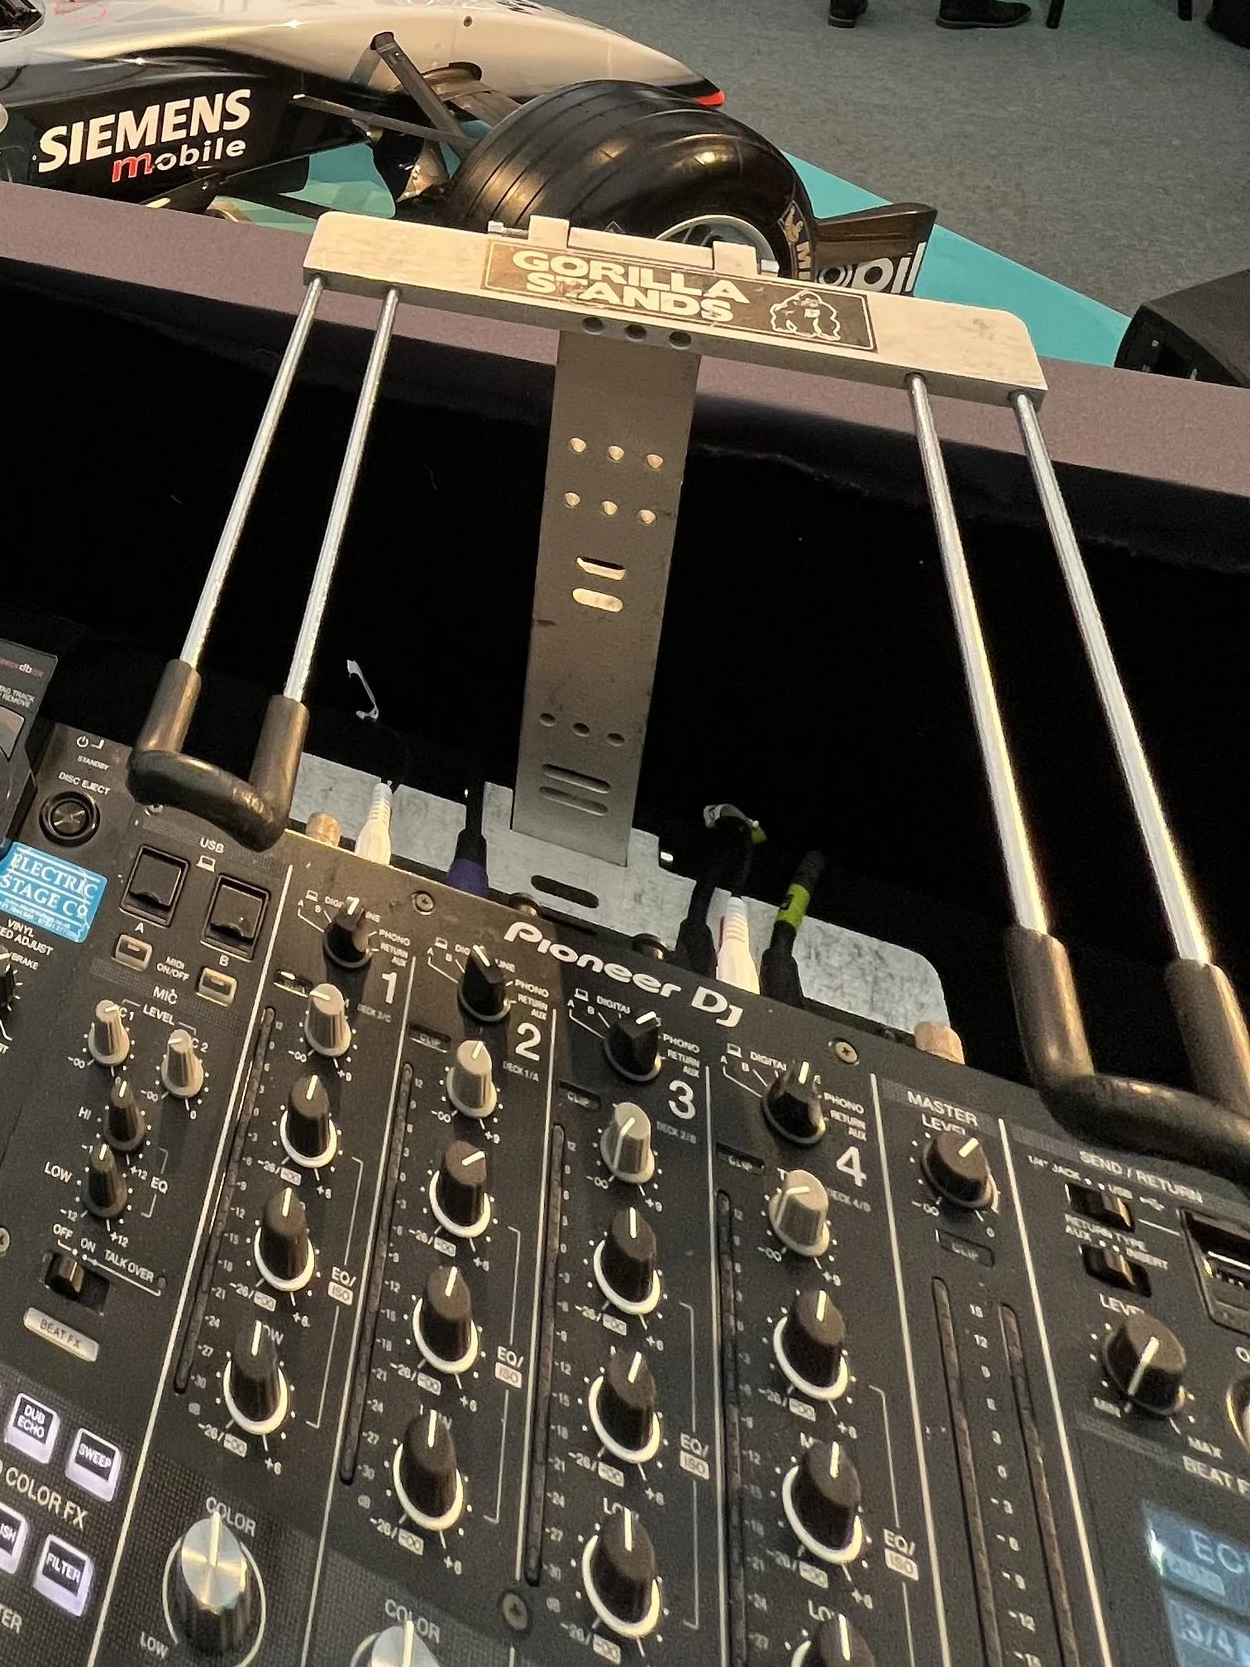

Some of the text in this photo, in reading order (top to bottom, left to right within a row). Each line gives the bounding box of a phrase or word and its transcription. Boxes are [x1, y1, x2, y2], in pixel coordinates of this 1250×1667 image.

[38, 89, 251, 173] SIEMENS
[112, 137, 246, 182] mobile
[512, 250, 750, 303] GORILLA
[527, 270, 734, 323] STANDS
[58, 772, 110, 796] DISC EJECT
[200, 838, 224, 854] USB
[11, 853, 98, 899] ELECTRIC
[0, 875, 60, 908] STAGE
[7, 918, 34, 938] VINYL
[135, 923, 144, 933] A
[379, 929, 411, 946] PHONO
[14, 934, 53, 956] ADJUST
[380, 943, 408, 958] RETURN
[157, 963, 189, 981] ON/OFF
[166, 956, 185, 969] MIDI
[219, 956, 229, 966] B
[504, 921, 744, 1028] Pioneer DJ
[153, 986, 178, 1005] MIC
[382, 972, 397, 1004] 1
[515, 979, 549, 998] PHONO
[518, 993, 548, 1011] RETURN
[143, 1005, 175, 1026] LEVEL
[516, 1023, 542, 1061] 2
[663, 1034, 700, 1053] PHONO
[667, 1050, 700, 1067] RETURN
[668, 1080, 696, 1119] 3
[824, 1092, 864, 1114] PHONO
[908, 1091, 978, 1127] MASTER
[78, 1107, 92, 1120] HI
[830, 1110, 866, 1129] RETURN
[44, 1162, 72, 1182] LOW
[836, 1146, 867, 1187] 4
[1079, 1151, 1203, 1203] SEND RETURN
[151, 1177, 168, 1193] EQ
[53, 1224, 73, 1239] OFF
[81, 1238, 96, 1252] ON
[104, 1249, 153, 1282] TALK OVER
[40, 1318, 80, 1348] BEAT FX
[24, 1405, 46, 1424] DUB
[17, 1415, 45, 1438] ECHO
[77, 1444, 112, 1468] SWEEP
[1183, 1456, 1233, 1489] BEAT
[6, 1467, 61, 1517] COLOR
[64, 1502, 89, 1530] FX
[45, 1553, 82, 1583] FILTER
[140, 1632, 169, 1660] LOW
